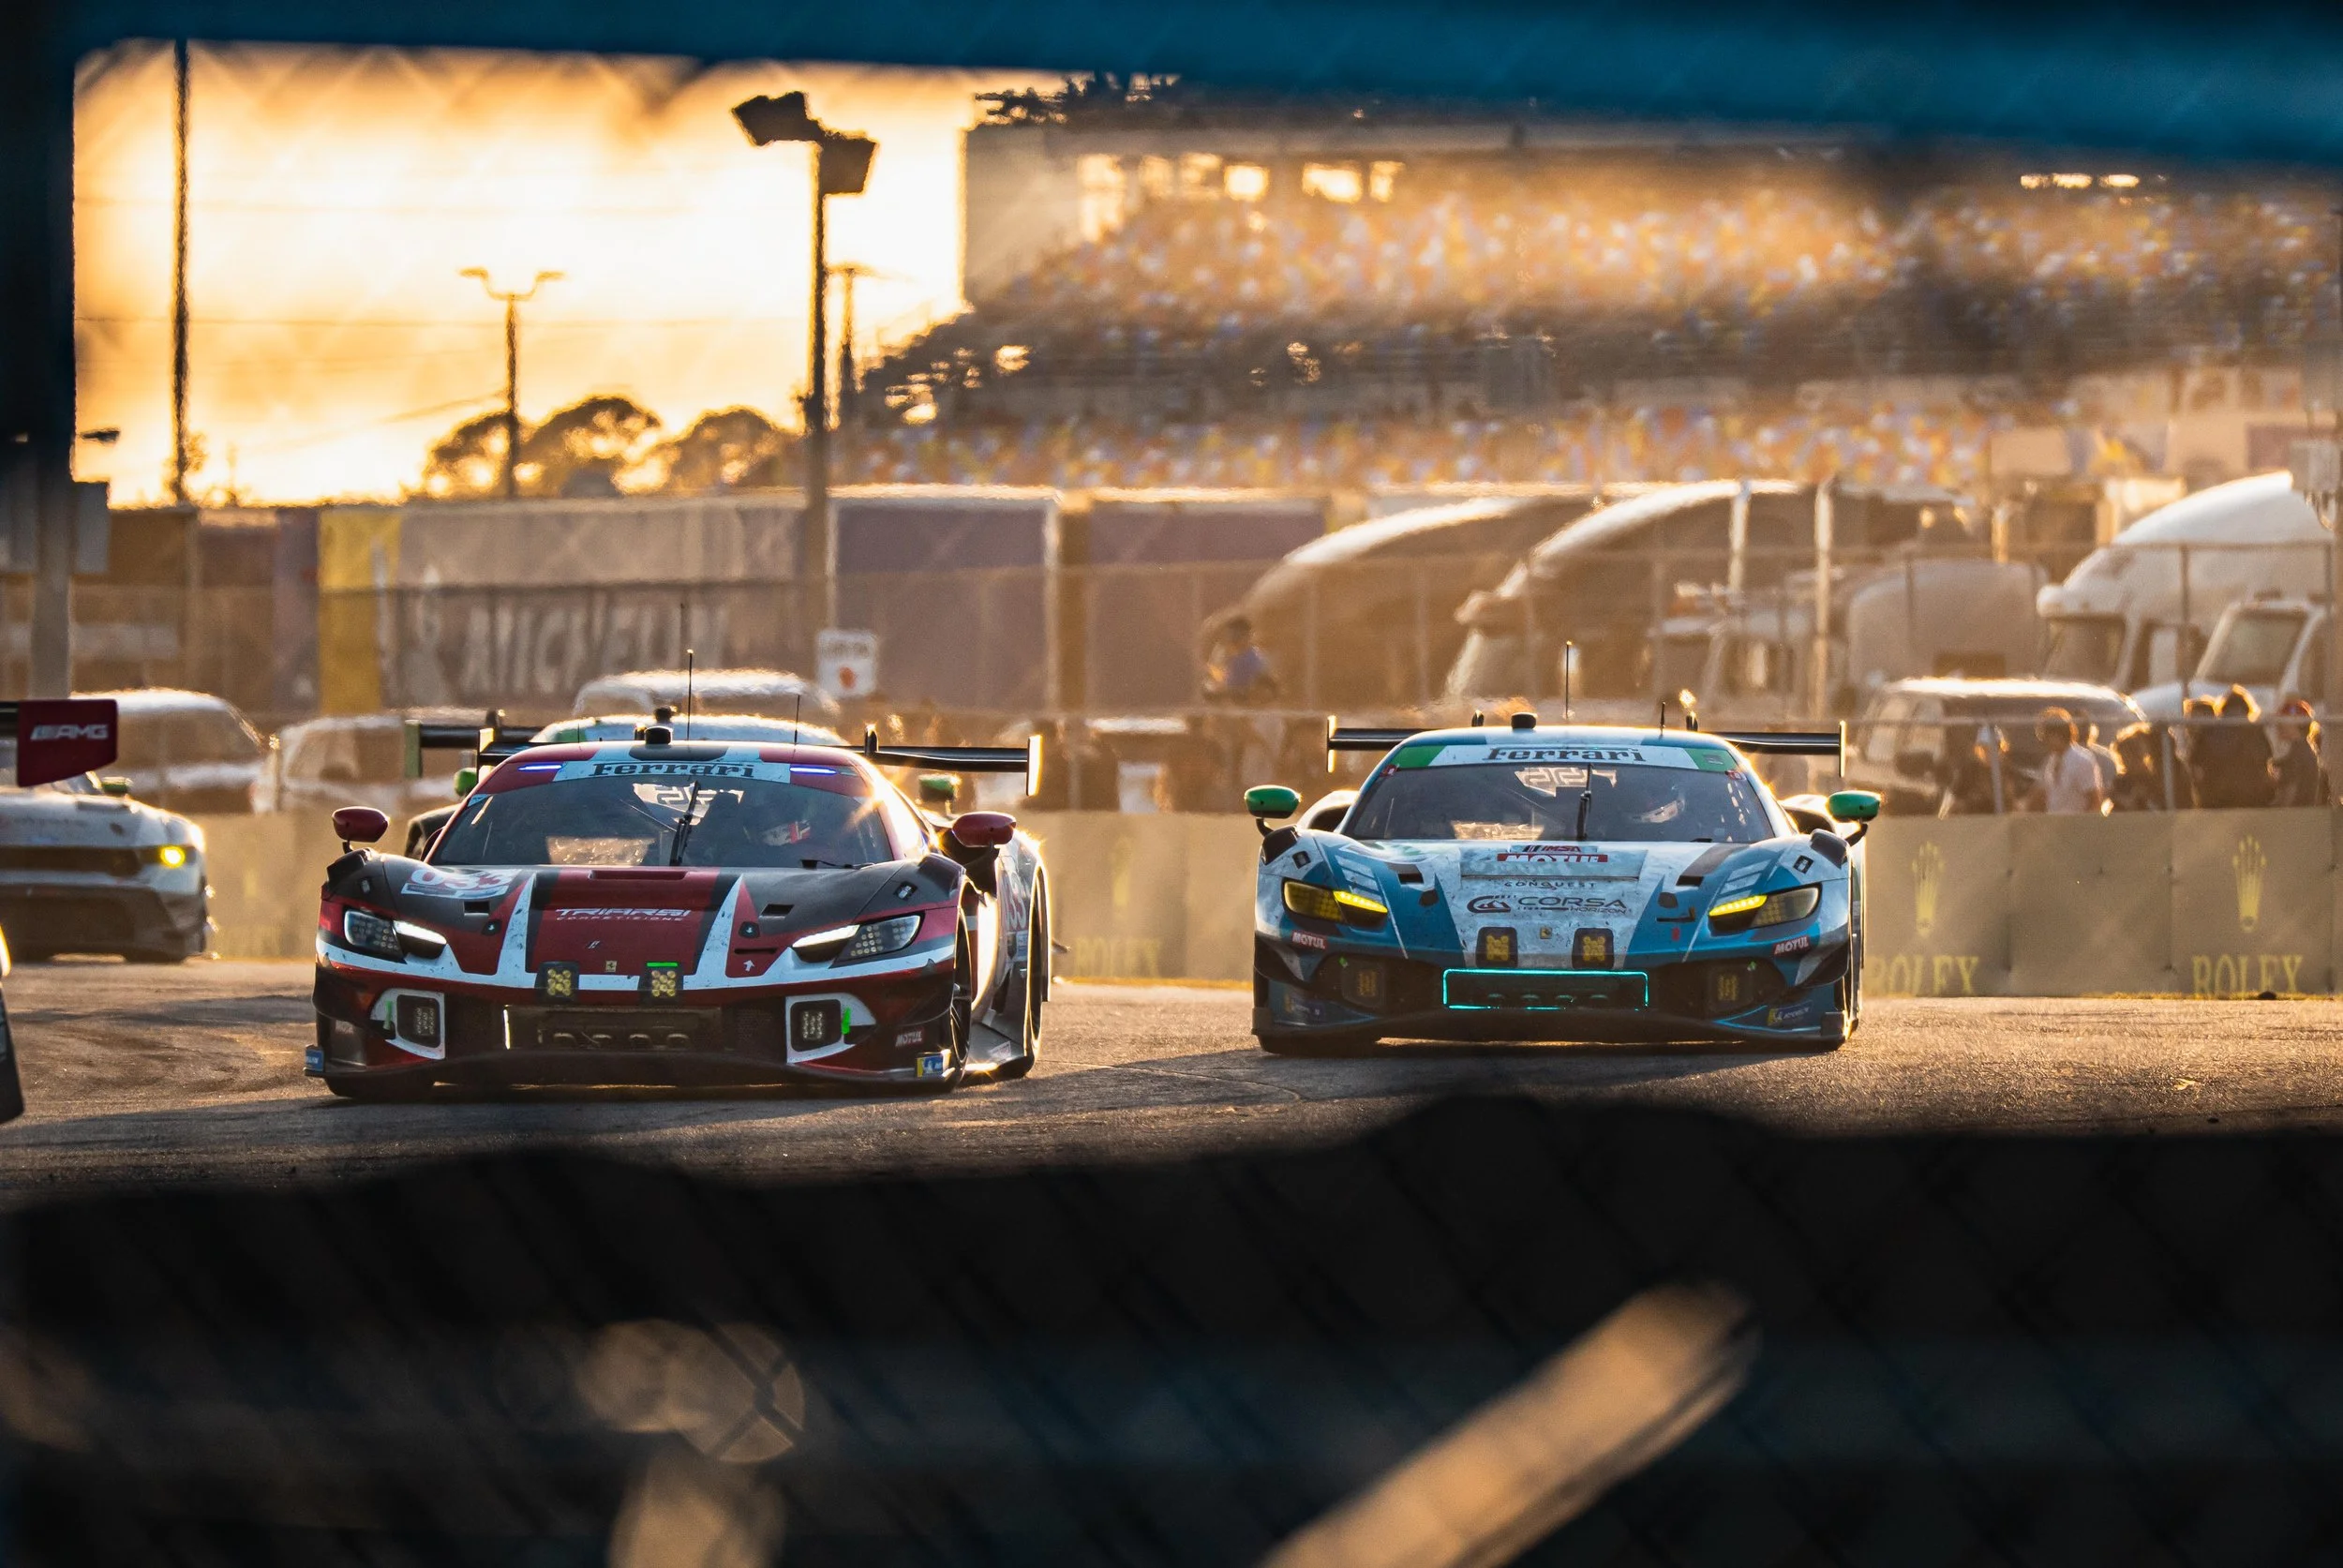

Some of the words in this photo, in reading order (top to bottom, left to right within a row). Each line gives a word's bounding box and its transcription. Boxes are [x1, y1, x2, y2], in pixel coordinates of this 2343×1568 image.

[55, 724, 109, 739] AMG
[1483, 747, 1647, 762] Ferrari
[589, 762, 754, 778] Ferrari
[1504, 880, 1597, 889] CONQUEST
[1518, 896, 1627, 908] CORSA
[556, 908, 692, 917] TRIARSI
[1570, 906, 1627, 915] HORIZON
[1292, 932, 1326, 949] MOTUL
[1774, 936, 1809, 954] MOTUL
[895, 1031, 923, 1047] MOTUL
